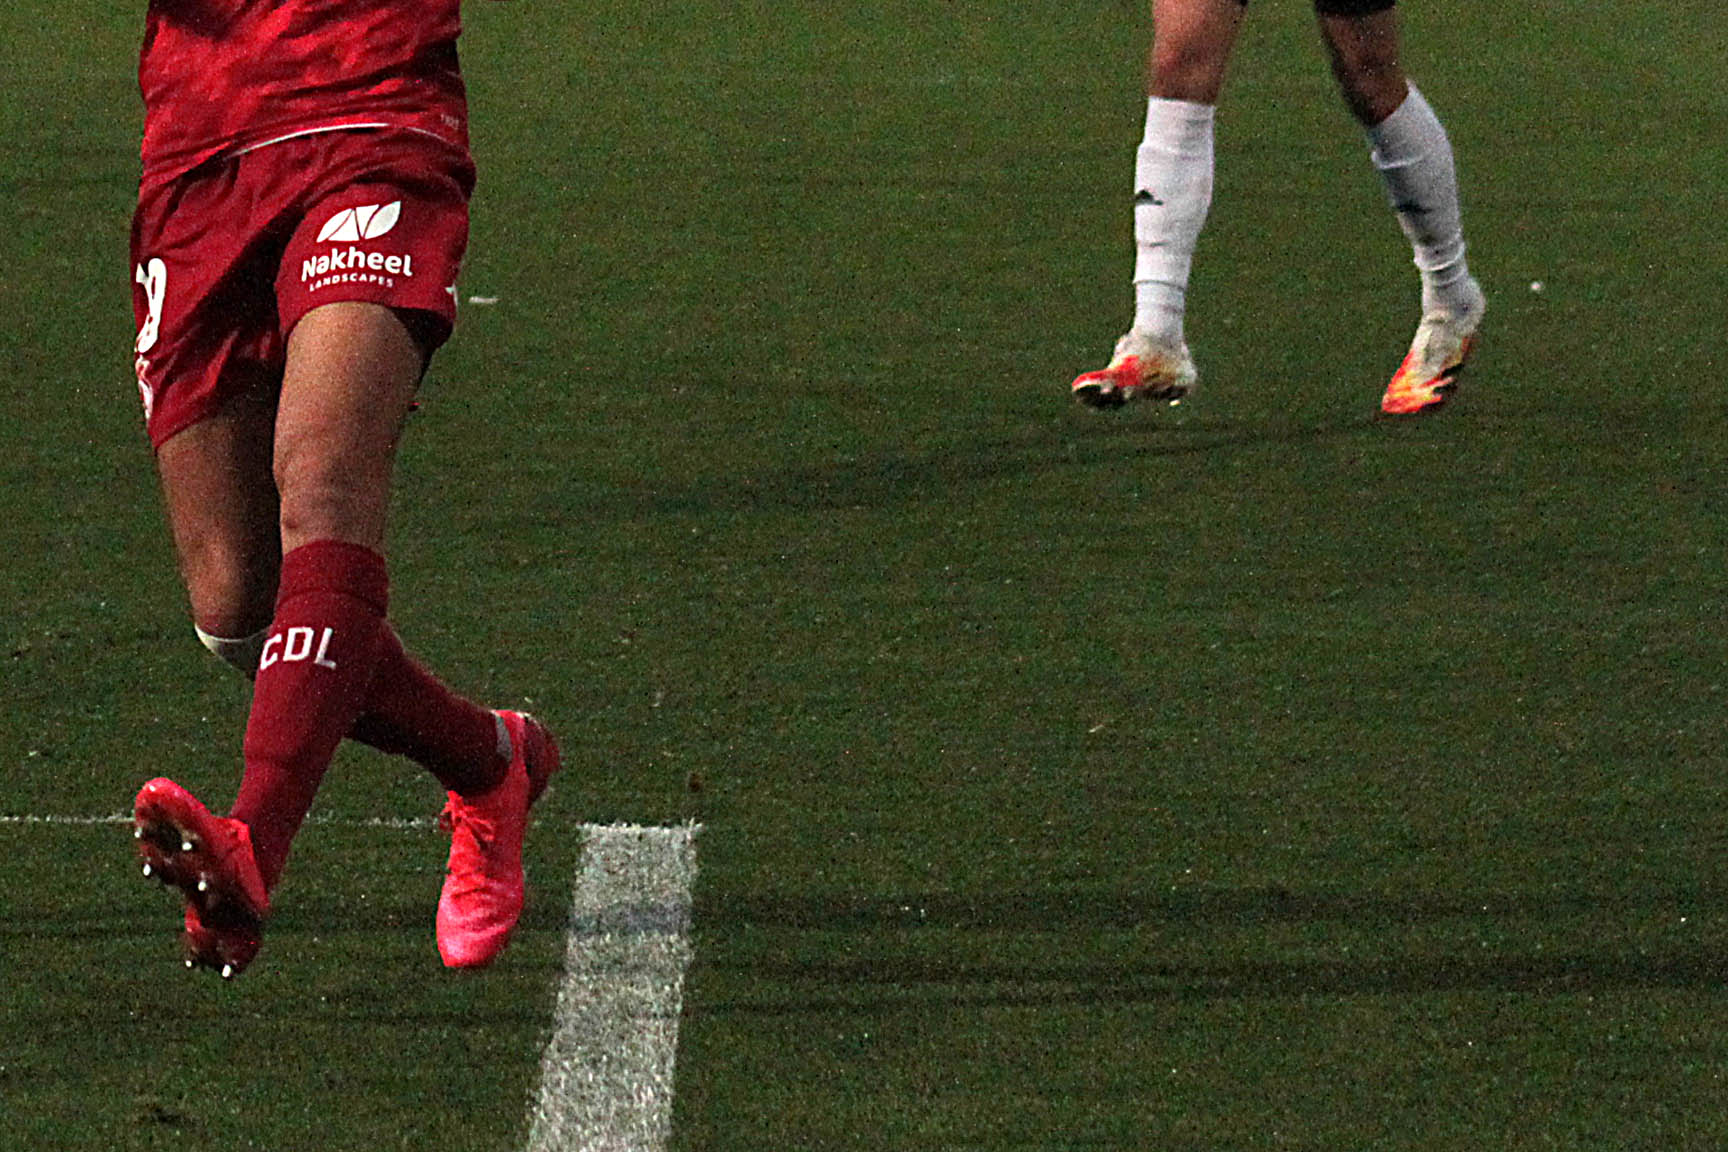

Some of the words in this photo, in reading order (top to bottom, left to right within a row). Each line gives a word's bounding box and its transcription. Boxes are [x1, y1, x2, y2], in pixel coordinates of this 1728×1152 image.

[301, 246, 413, 282] Nakheel
[309, 272, 394, 292] LANDSCAPES
[260, 627, 337, 670] CDL
